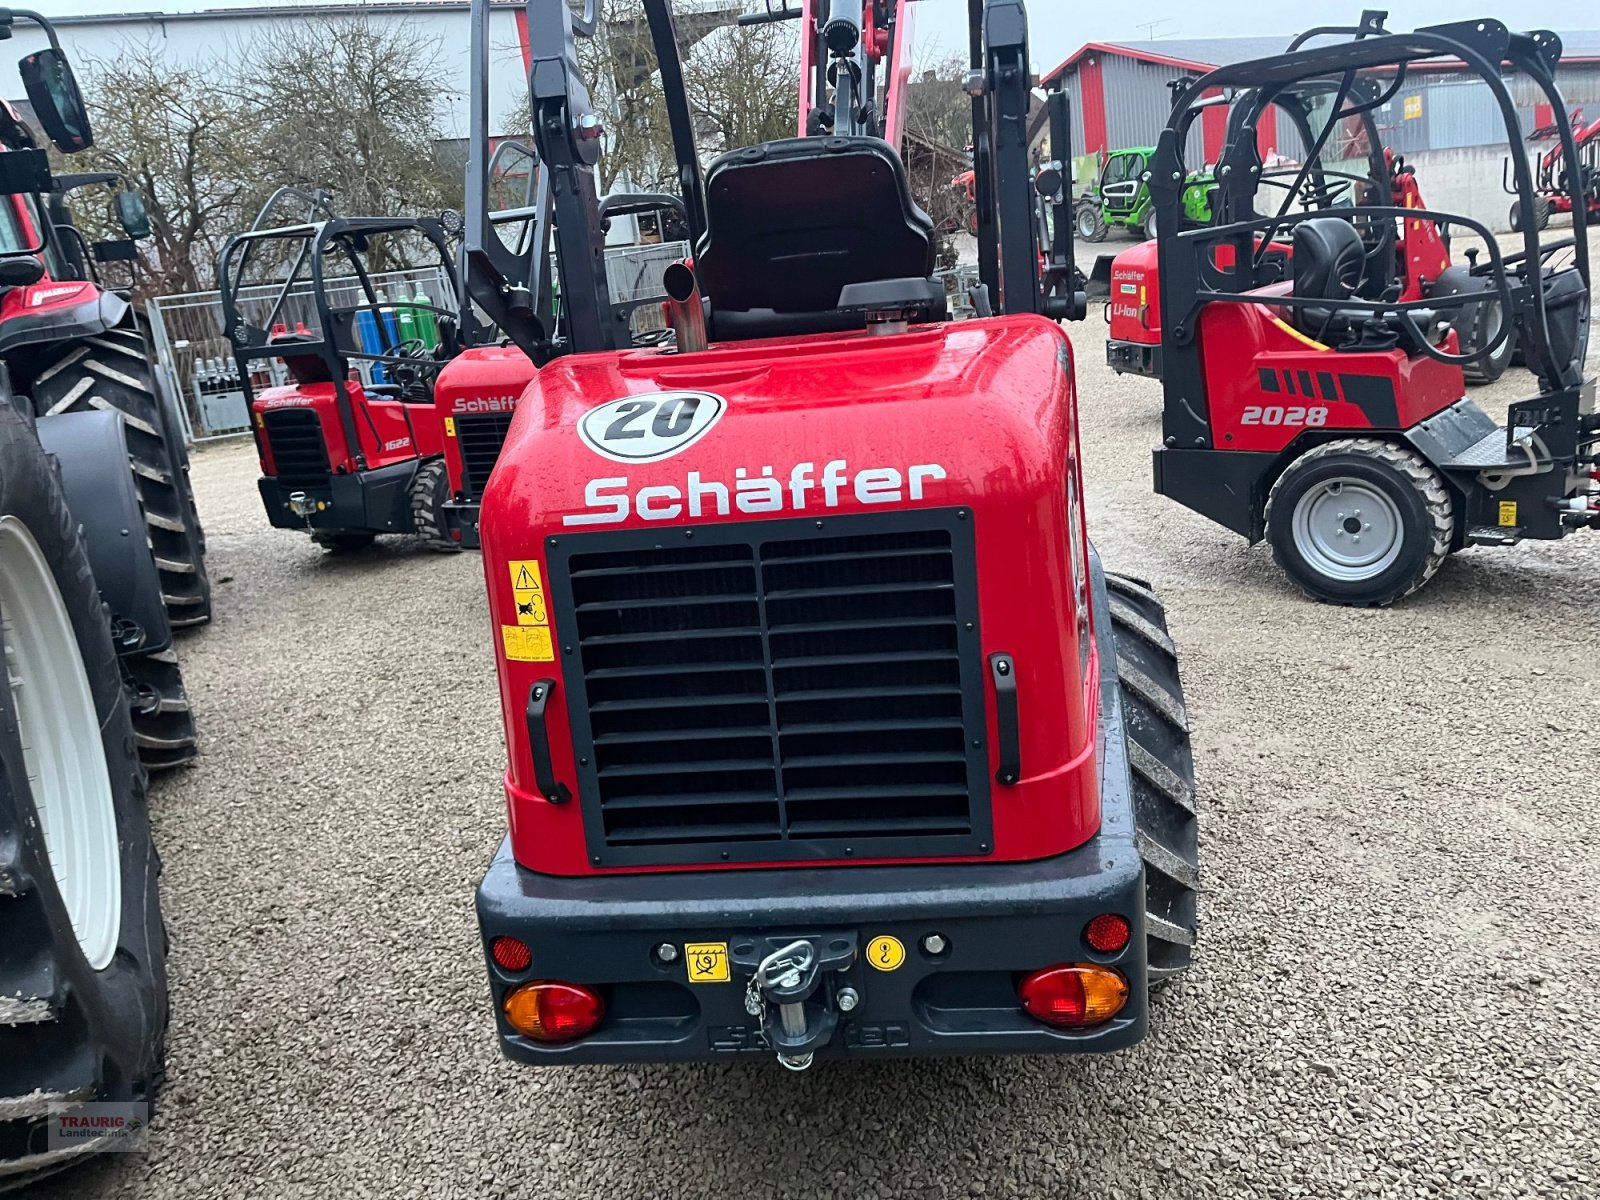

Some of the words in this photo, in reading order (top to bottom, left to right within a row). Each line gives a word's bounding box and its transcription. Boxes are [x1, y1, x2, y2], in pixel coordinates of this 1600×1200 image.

[451, 395, 520, 412] Schäff
[603, 397, 702, 441] 20
[1240, 406, 1329, 426] 2028
[385, 437, 410, 451] 1622
[562, 460, 946, 526] Schäffer
